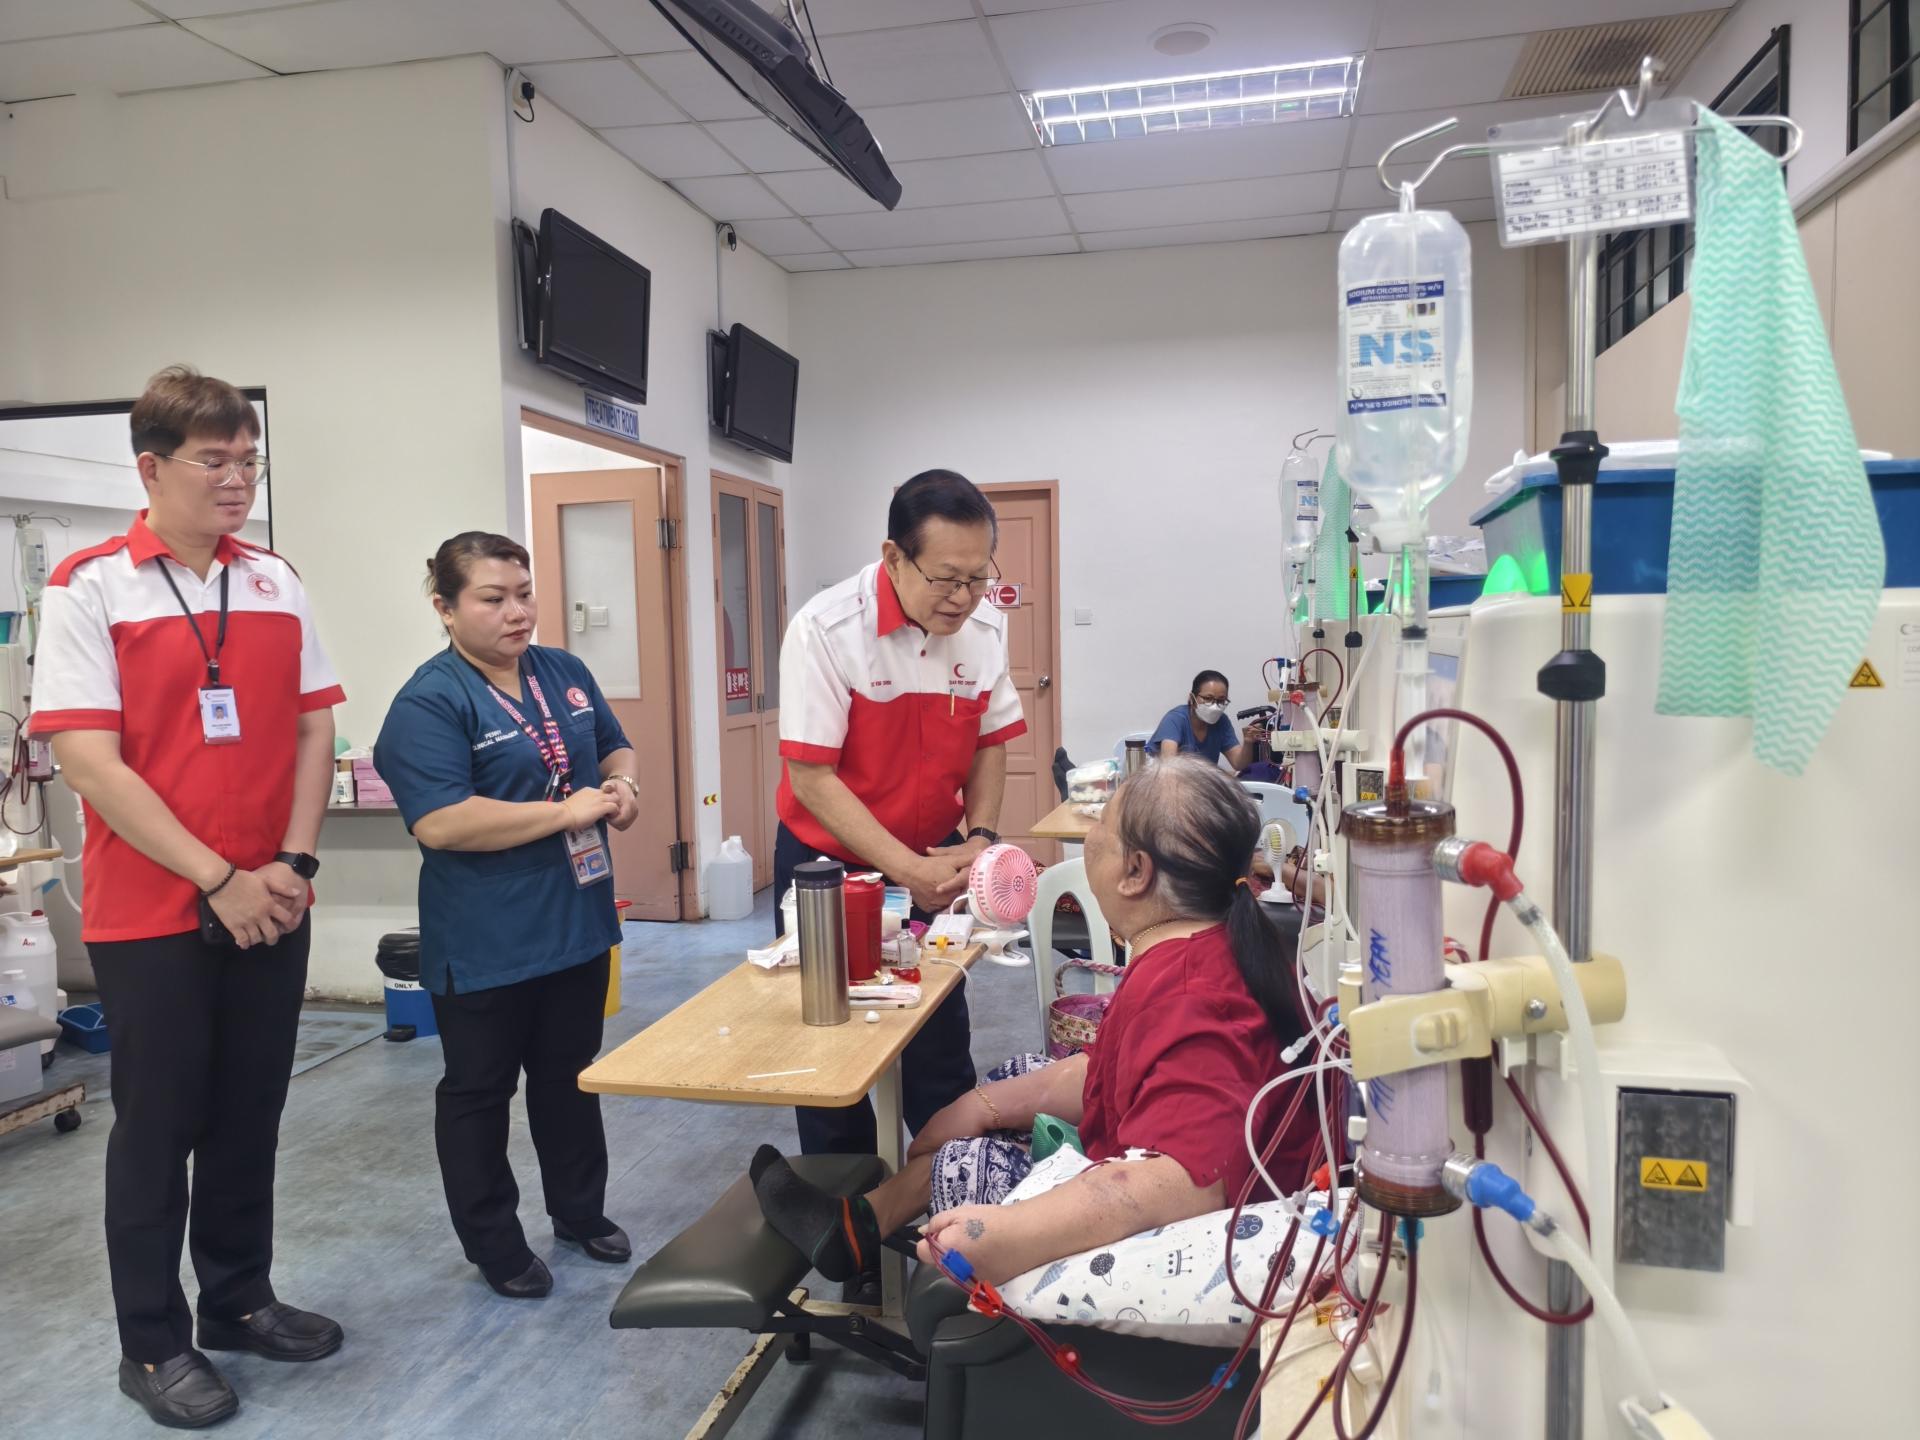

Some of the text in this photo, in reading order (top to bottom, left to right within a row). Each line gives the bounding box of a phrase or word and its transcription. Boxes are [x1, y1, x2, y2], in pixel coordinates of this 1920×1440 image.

[1348, 287, 1375, 298] SODIUM
[1376, 286, 1409, 295] CHLORIDE
[1359, 330, 1434, 364] NS
[587, 398, 638, 437] TREATMENT ROOM
